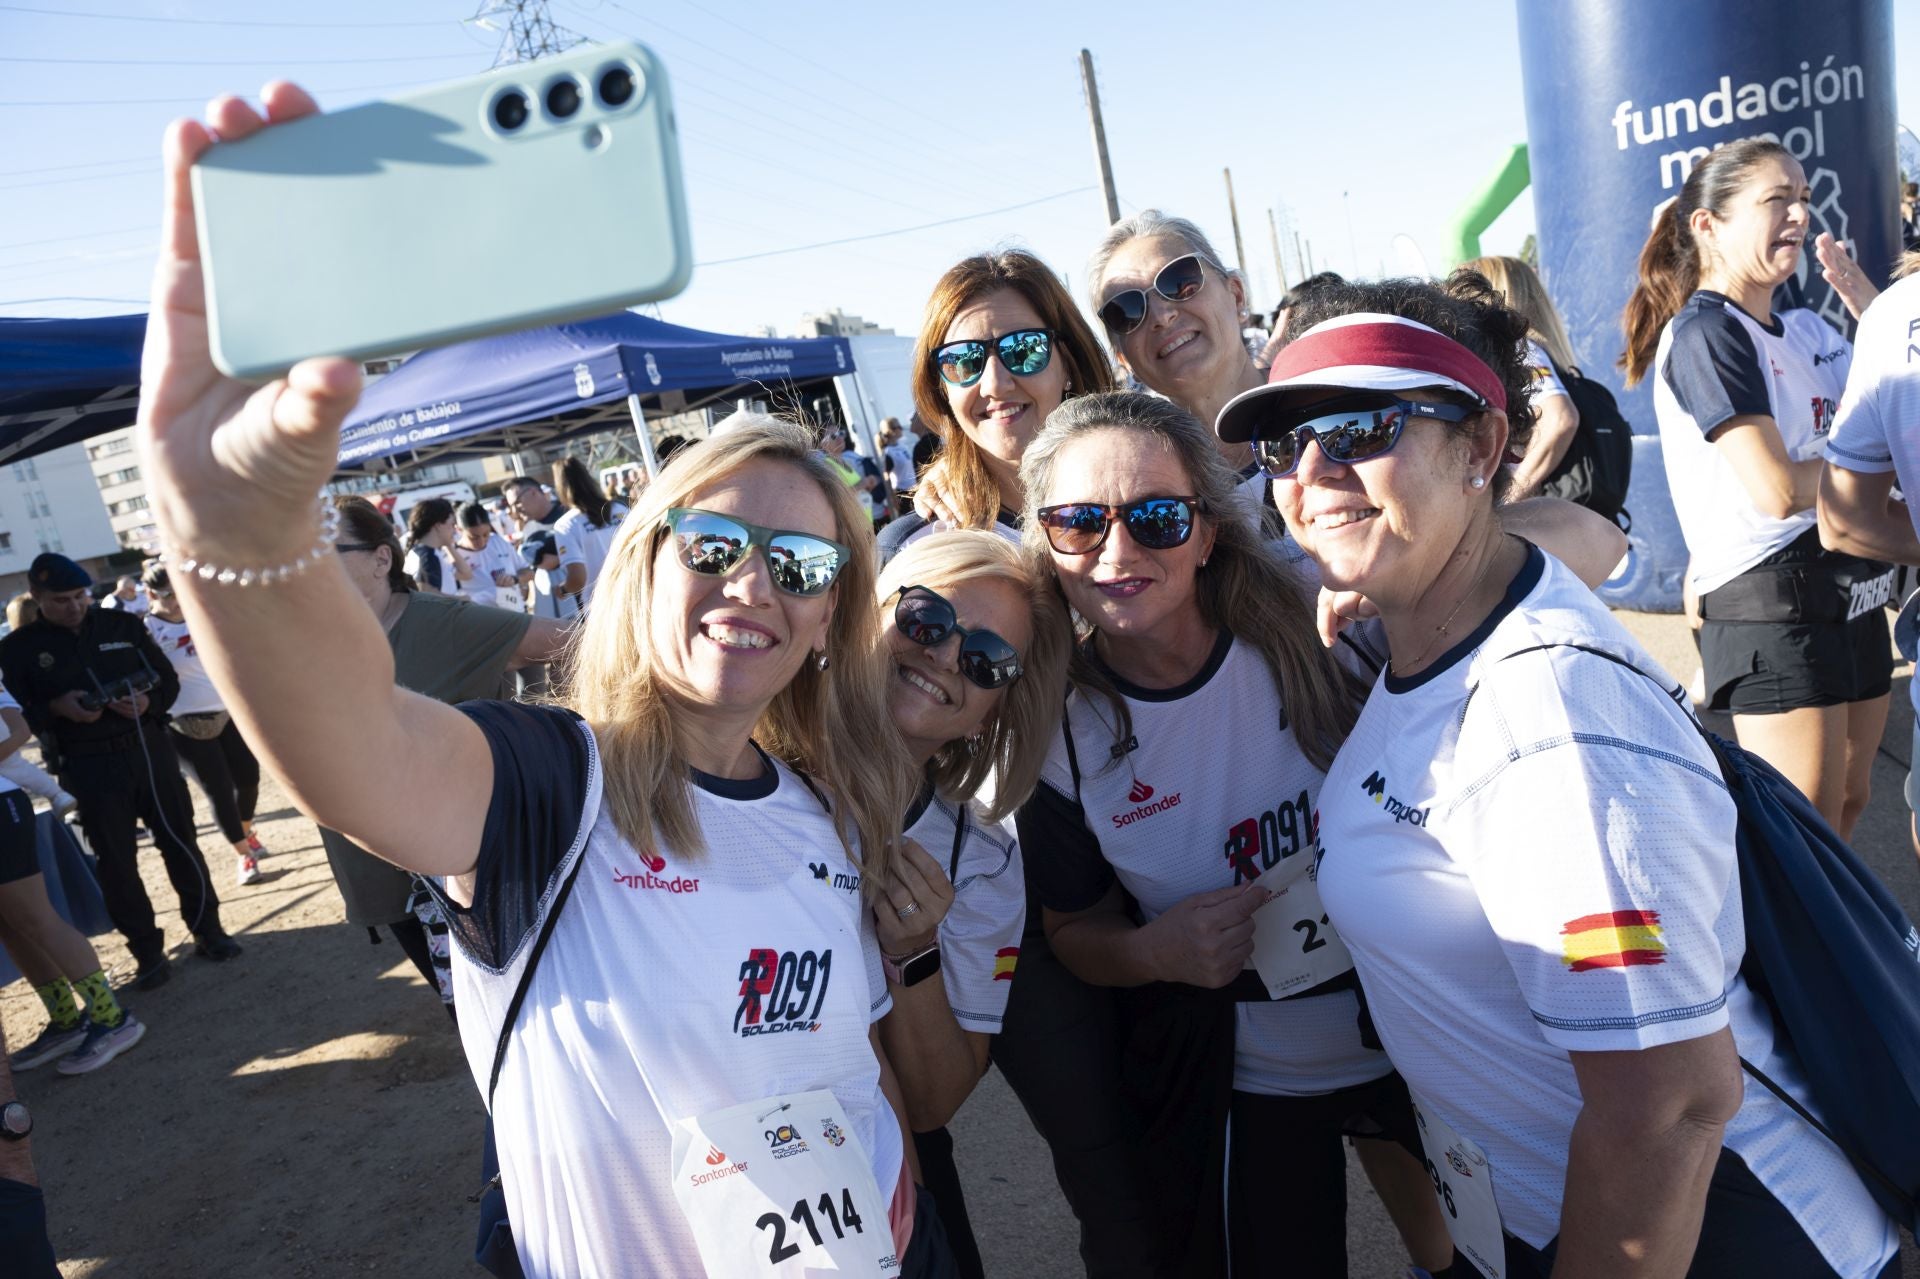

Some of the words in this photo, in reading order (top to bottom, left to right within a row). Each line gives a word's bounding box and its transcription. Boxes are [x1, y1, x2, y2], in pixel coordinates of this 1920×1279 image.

[1611, 55, 1864, 151] fundación
[1660, 110, 1825, 189] mol
[341, 417, 397, 444] ntamiento
[399, 411, 415, 428] de
[415, 401, 462, 423] Badajoz
[391, 433, 408, 447] de
[408, 423, 450, 442] Cultura
[1847, 569, 1895, 621] 226ERS
[1112, 792, 1182, 829] Santander
[833, 872, 860, 895] mup
[1292, 911, 1330, 954] 2
[734, 948, 832, 1033] R091
[742, 1020, 817, 1038] SOLIDARIA
[690, 1160, 749, 1187] Santander
[774, 1147, 811, 1160] NACIONAL
[755, 1187, 864, 1265] 2114
